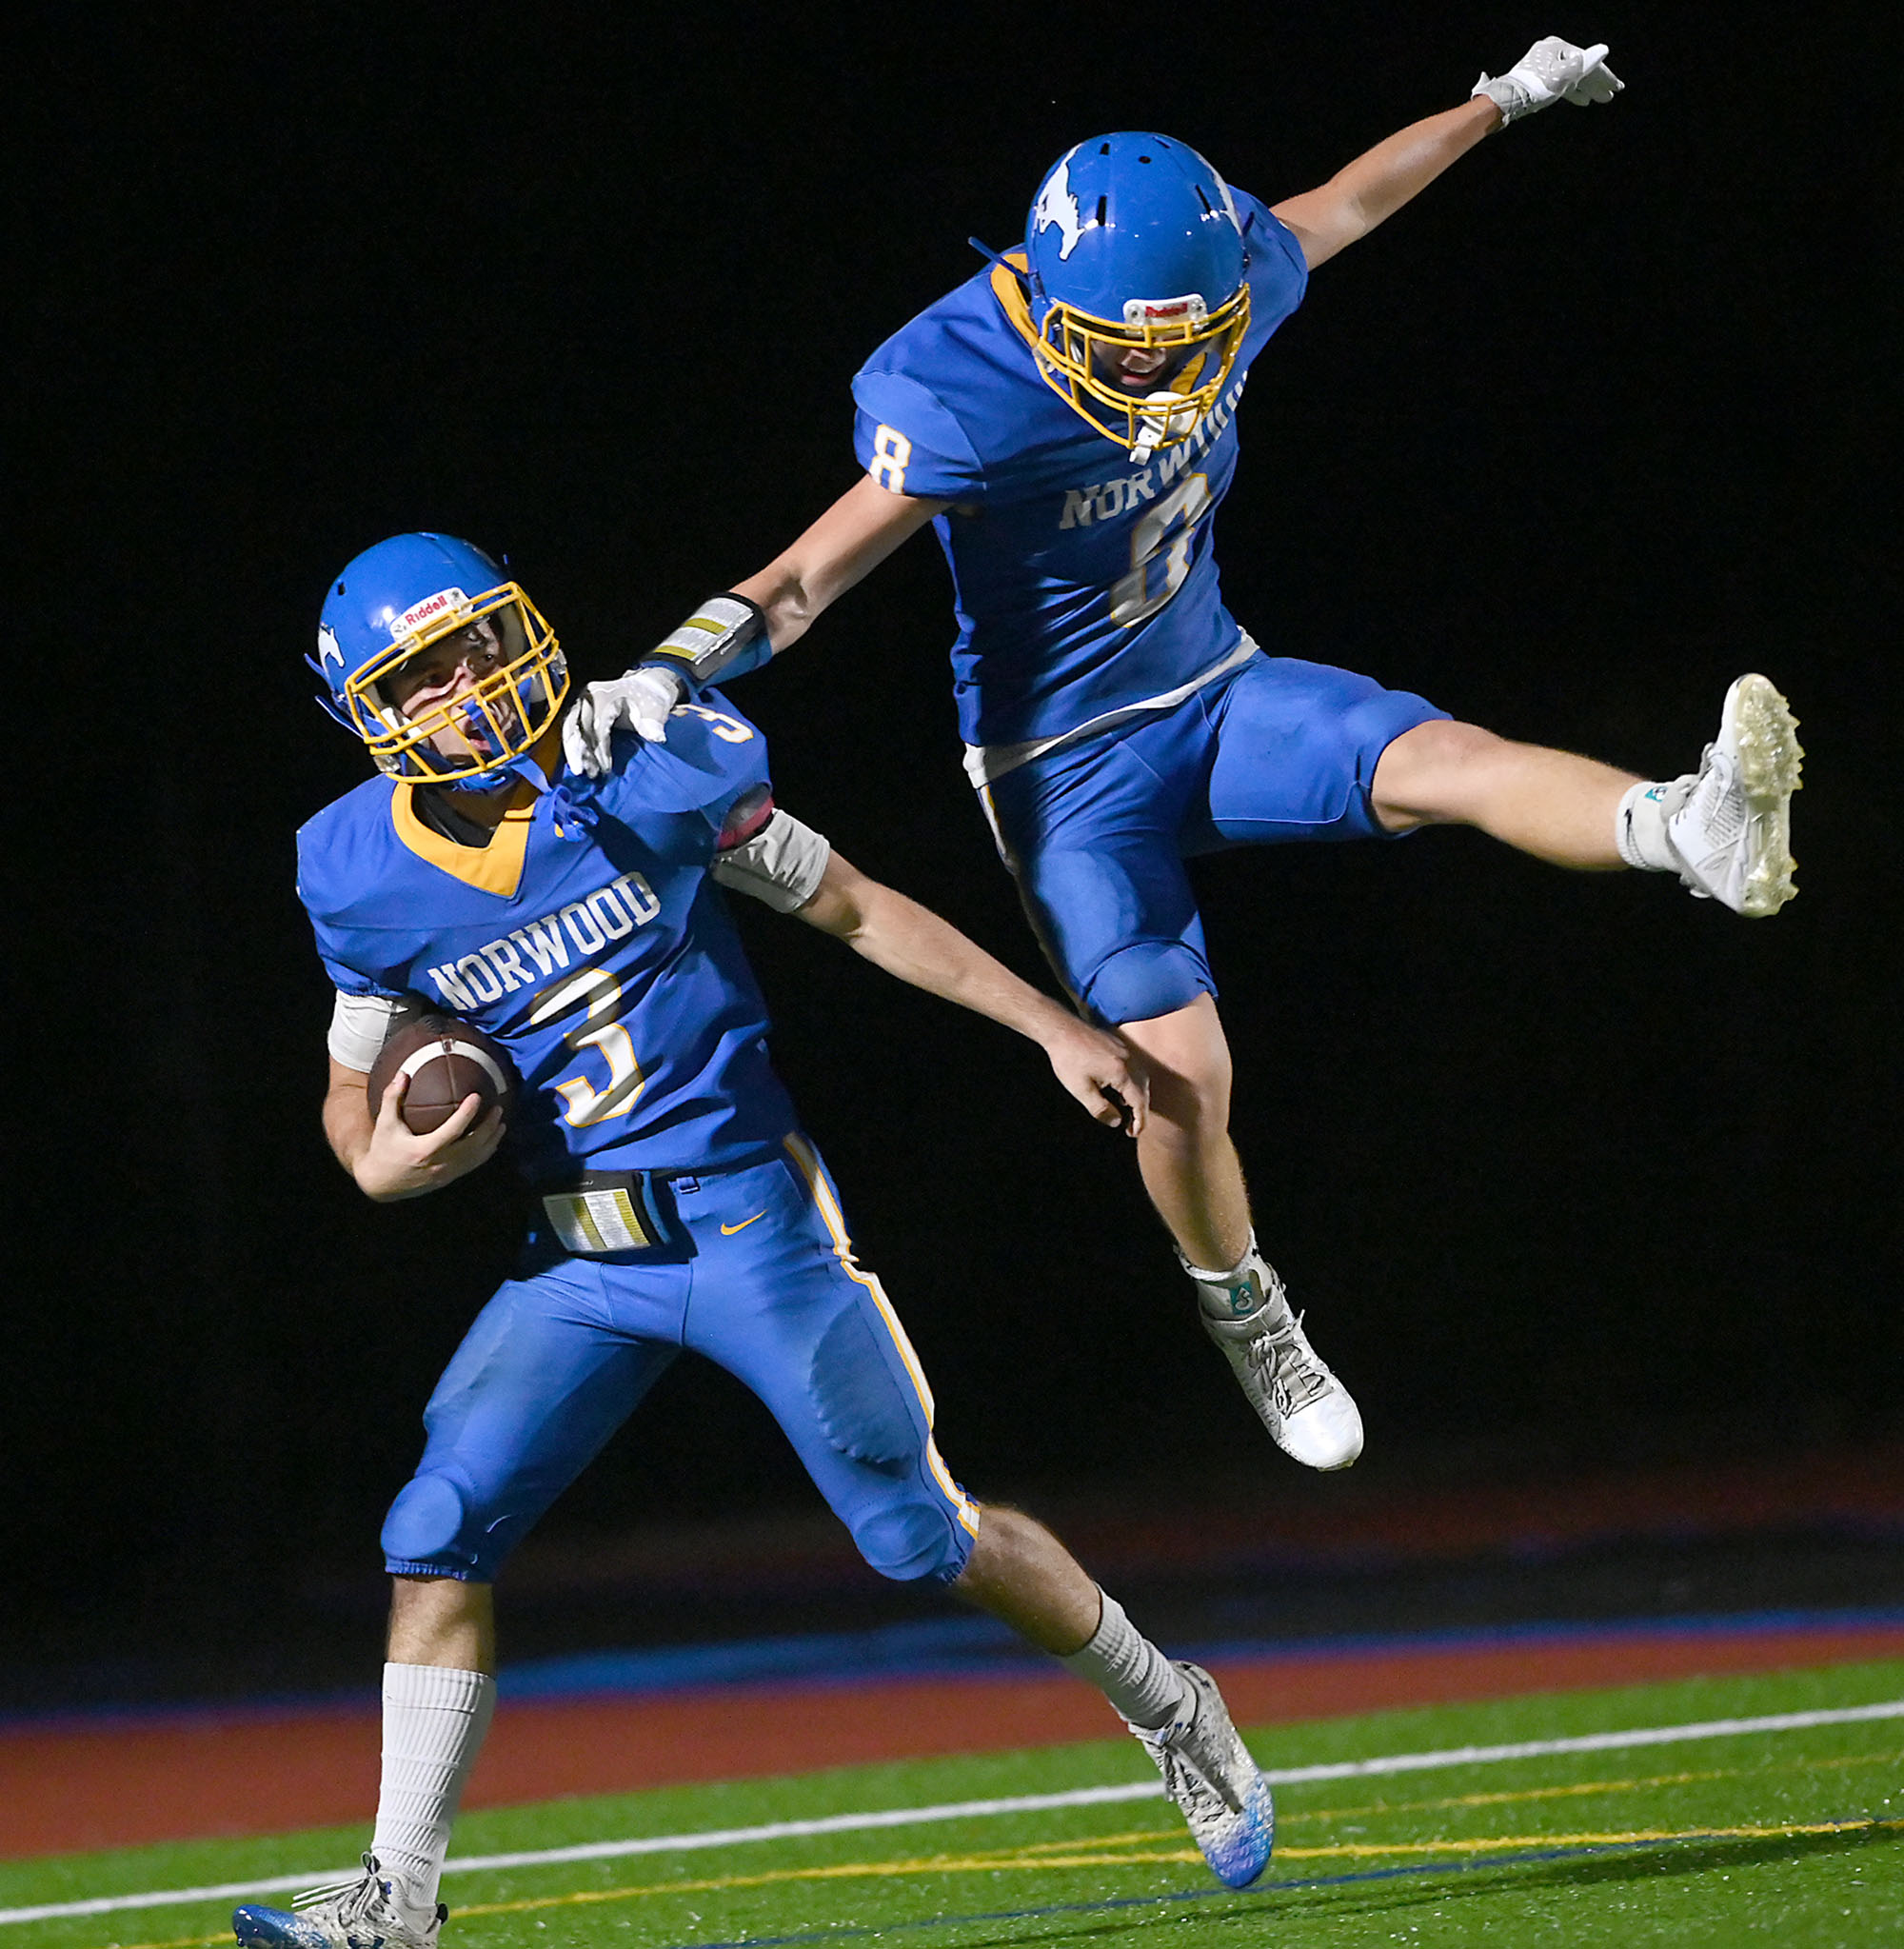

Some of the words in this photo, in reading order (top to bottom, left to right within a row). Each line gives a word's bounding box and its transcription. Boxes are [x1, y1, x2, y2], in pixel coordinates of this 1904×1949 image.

[868, 424, 912, 495] 8
[1059, 369, 1248, 530] NORW
[405, 595, 448, 626] Riddell
[1110, 472, 1213, 628] 8
[670, 704, 754, 744] 3
[427, 870, 662, 1011] NORWOOD
[528, 966, 645, 1128] 3
